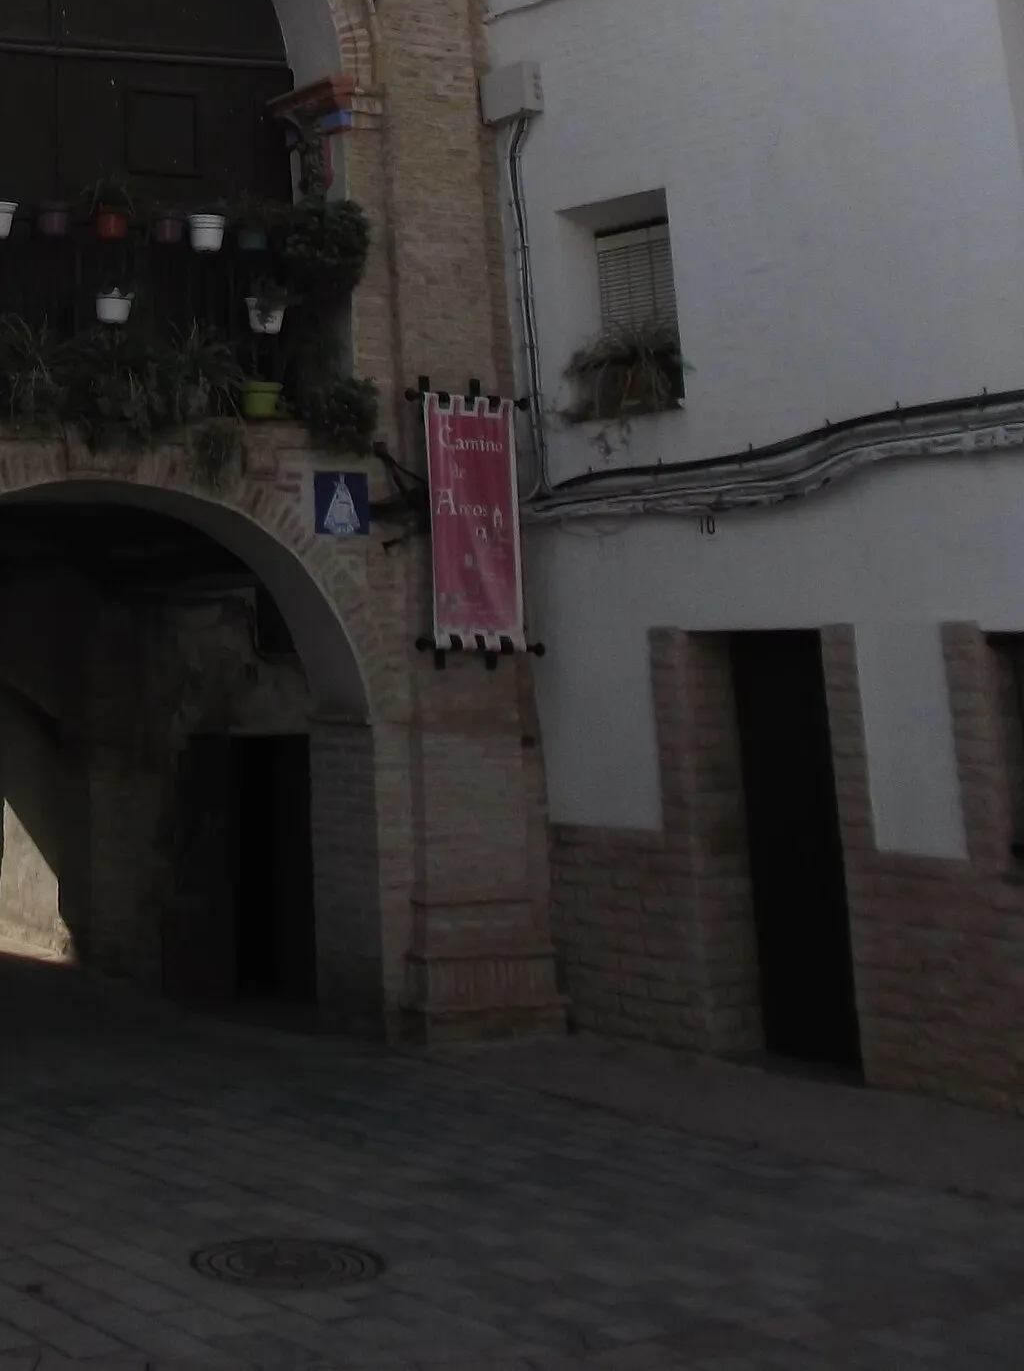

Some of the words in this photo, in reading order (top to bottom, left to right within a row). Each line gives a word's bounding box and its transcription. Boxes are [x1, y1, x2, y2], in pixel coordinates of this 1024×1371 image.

[438, 422, 503, 453] Camino
[436, 488, 488, 517] Arcos
[700, 515, 716, 535] 10
